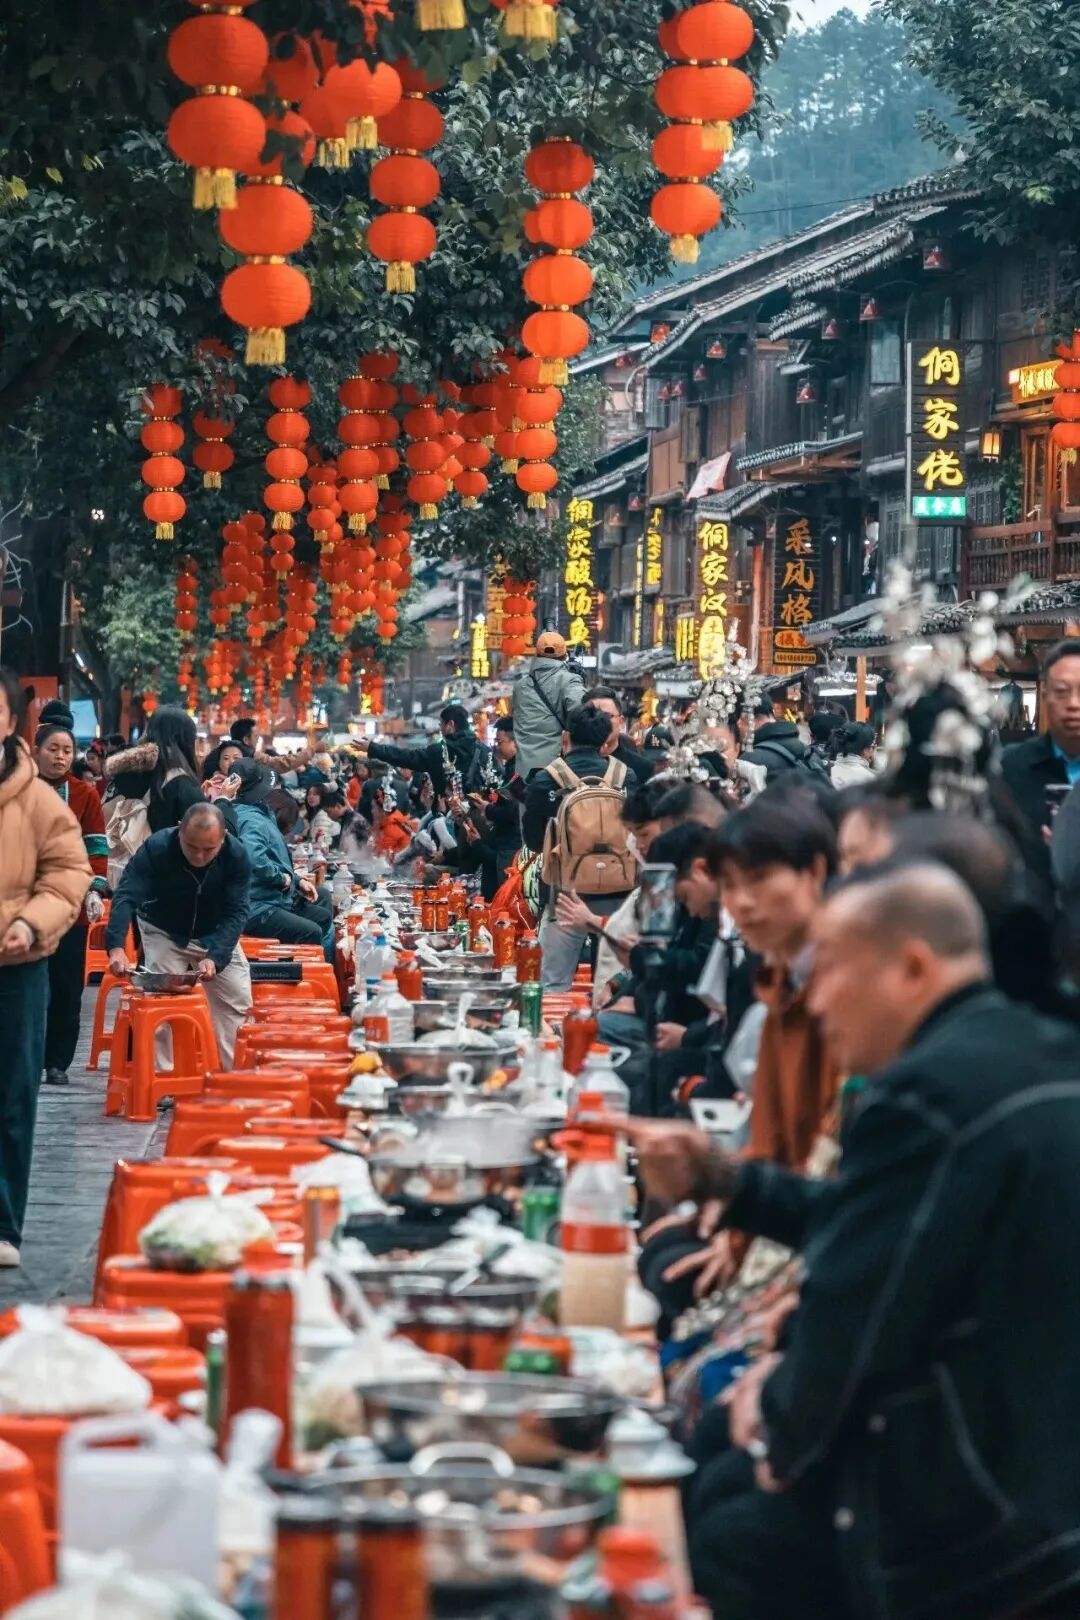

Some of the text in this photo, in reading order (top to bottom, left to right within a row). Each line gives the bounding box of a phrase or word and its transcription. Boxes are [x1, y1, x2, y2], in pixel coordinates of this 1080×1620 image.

[917, 345, 963, 491] 侗家佬
[781, 517, 815, 625] 采风格
